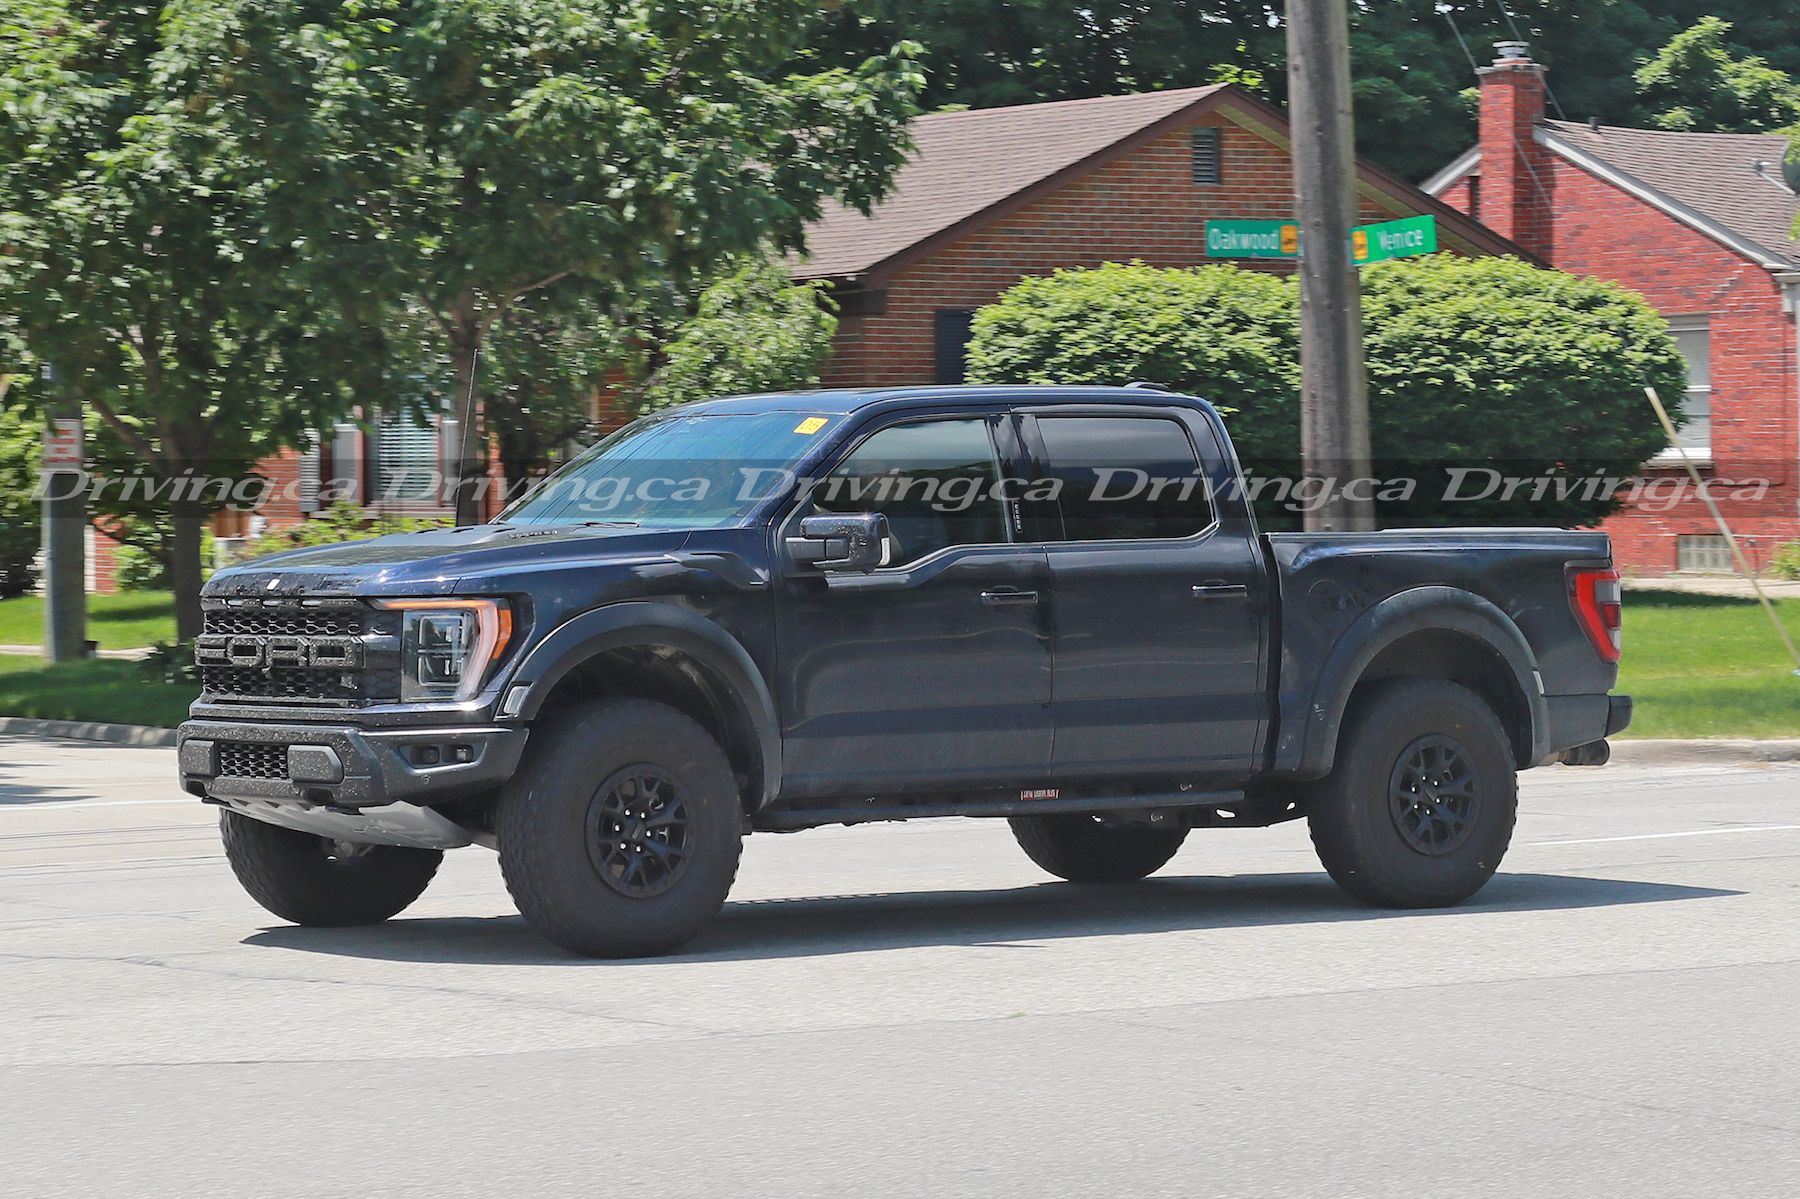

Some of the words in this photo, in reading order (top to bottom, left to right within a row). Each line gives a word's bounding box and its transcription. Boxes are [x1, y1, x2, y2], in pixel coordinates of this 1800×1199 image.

[1208, 228, 1280, 250] Oakwood
[1376, 229, 1424, 251] Venice
[194, 633, 364, 667] FORD
